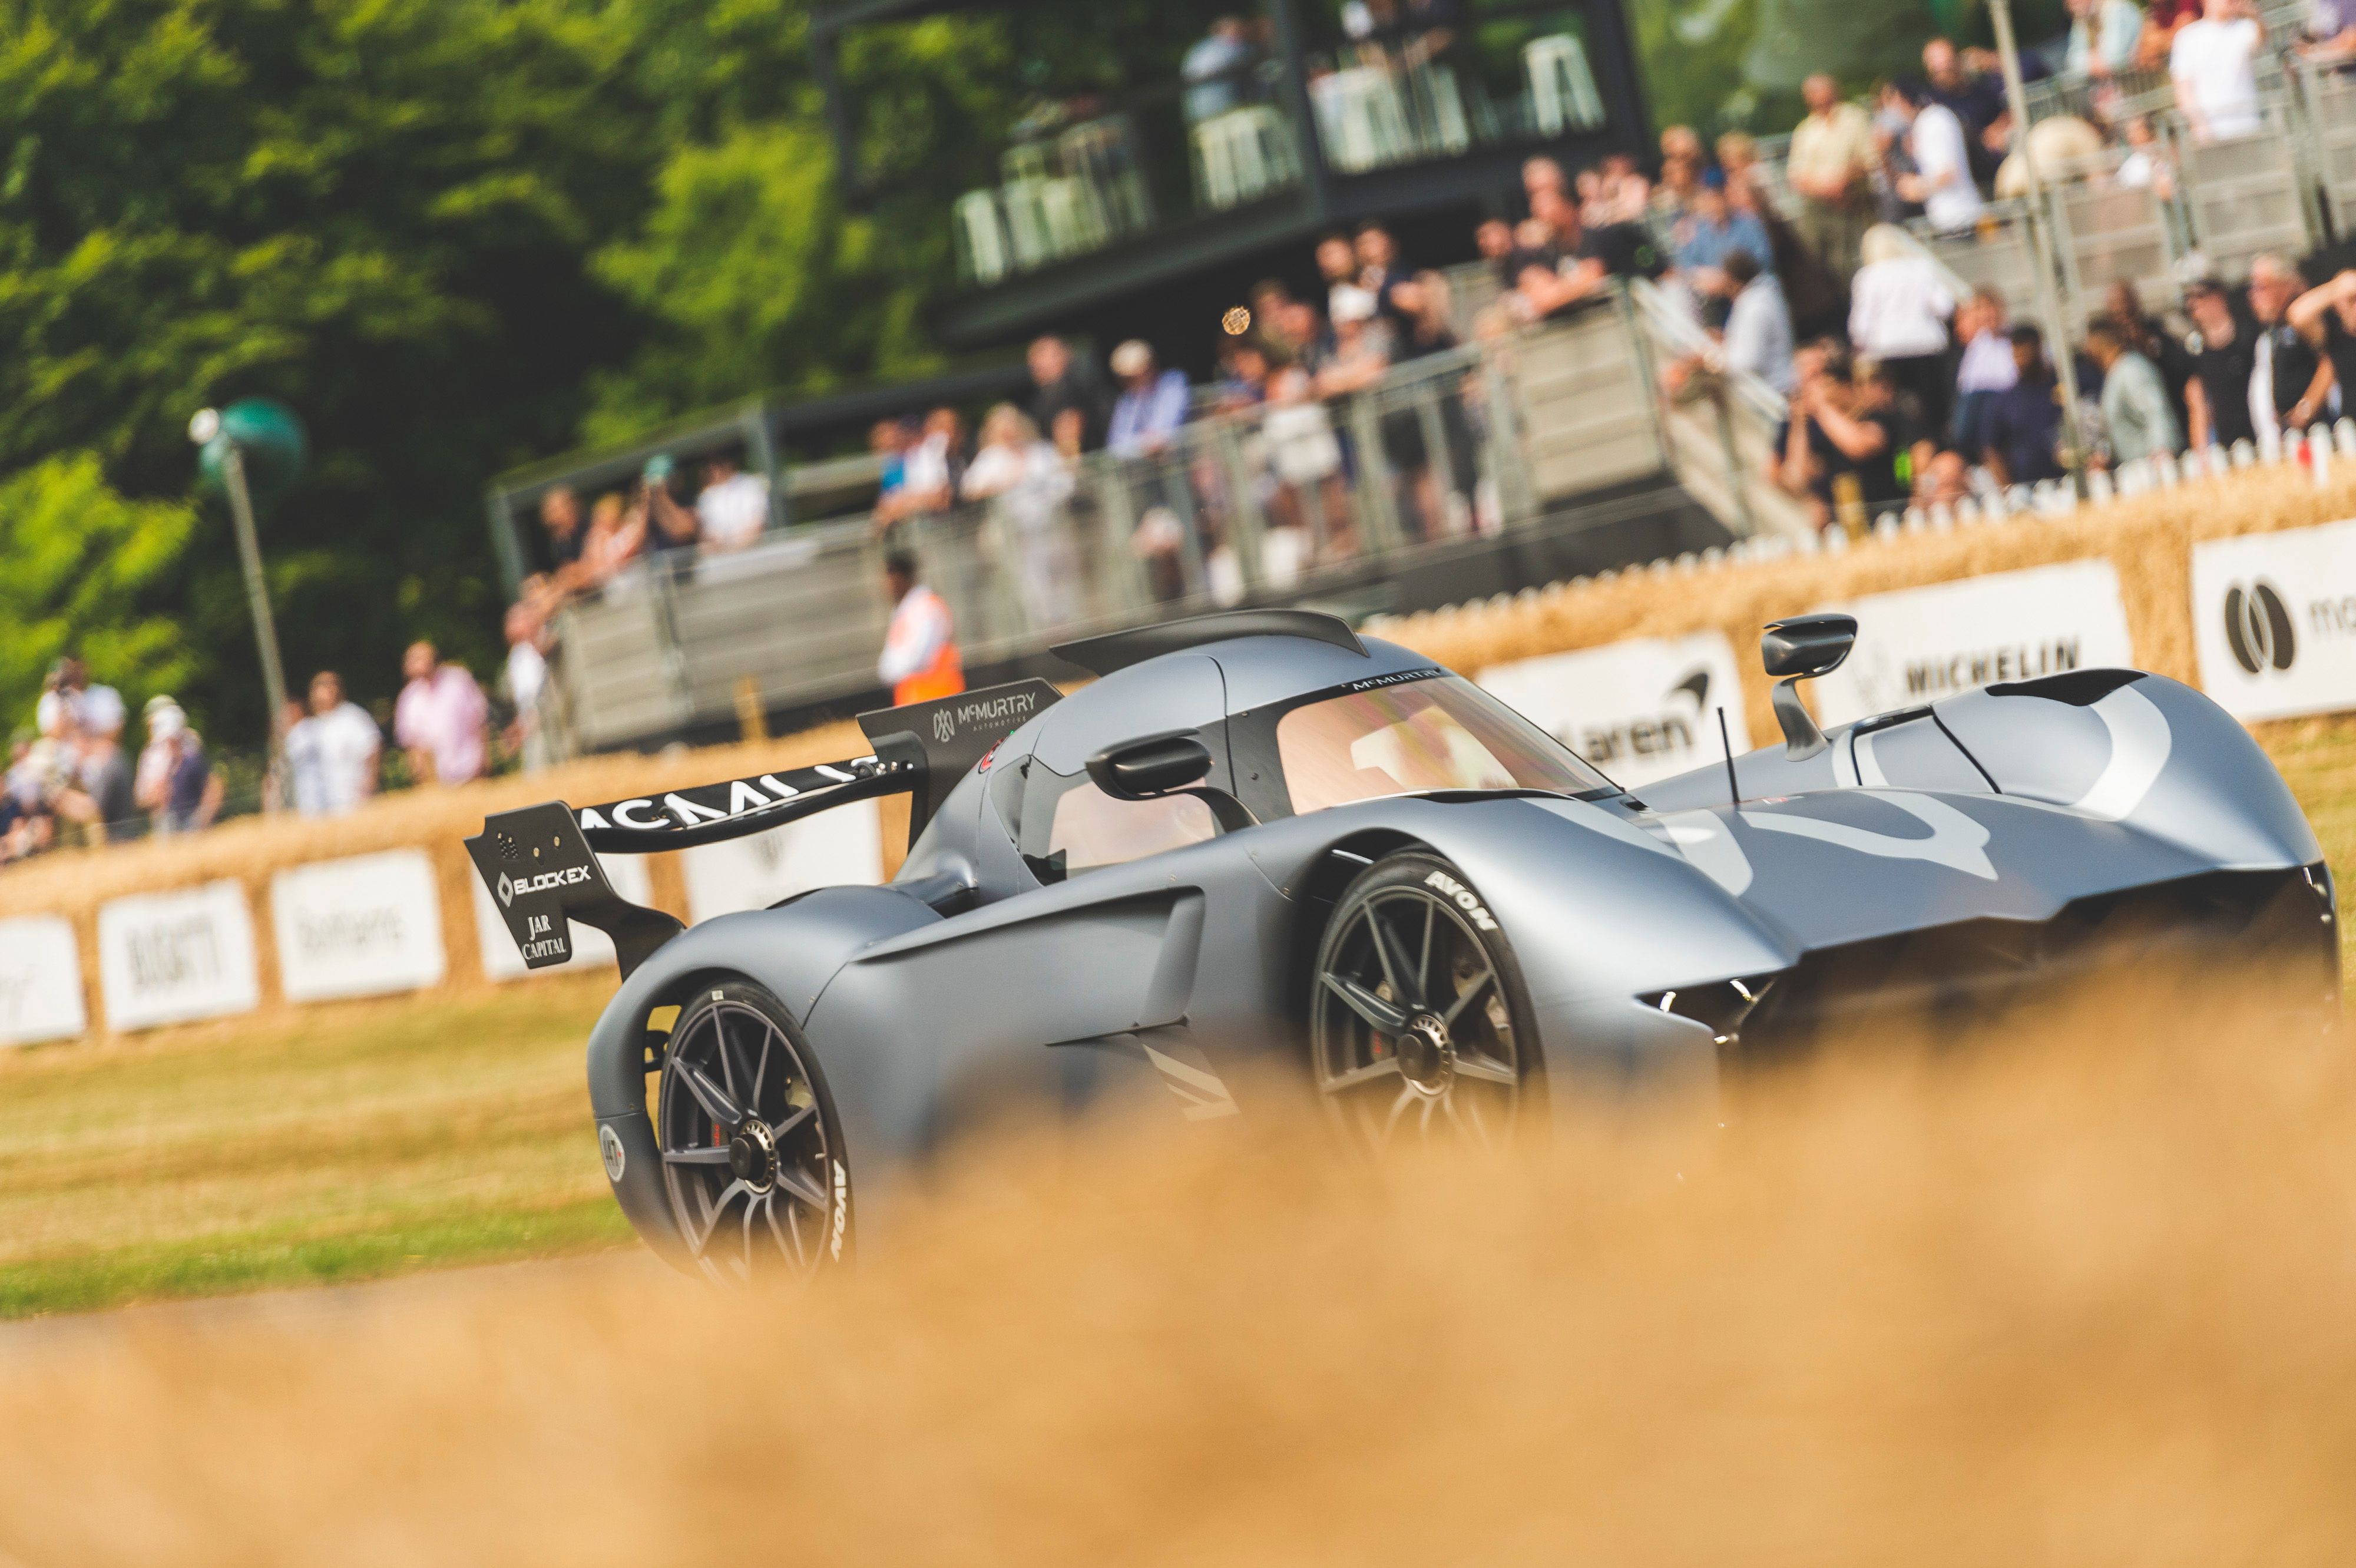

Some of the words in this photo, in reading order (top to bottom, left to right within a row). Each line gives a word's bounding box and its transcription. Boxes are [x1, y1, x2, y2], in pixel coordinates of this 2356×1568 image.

[1904, 634, 2082, 695] MICHELIN
[528, 915, 552, 941] JAR
[1424, 870, 1499, 931] AVON
[521, 938, 567, 960] CAPITAL
[830, 1159, 847, 1263] AVON
